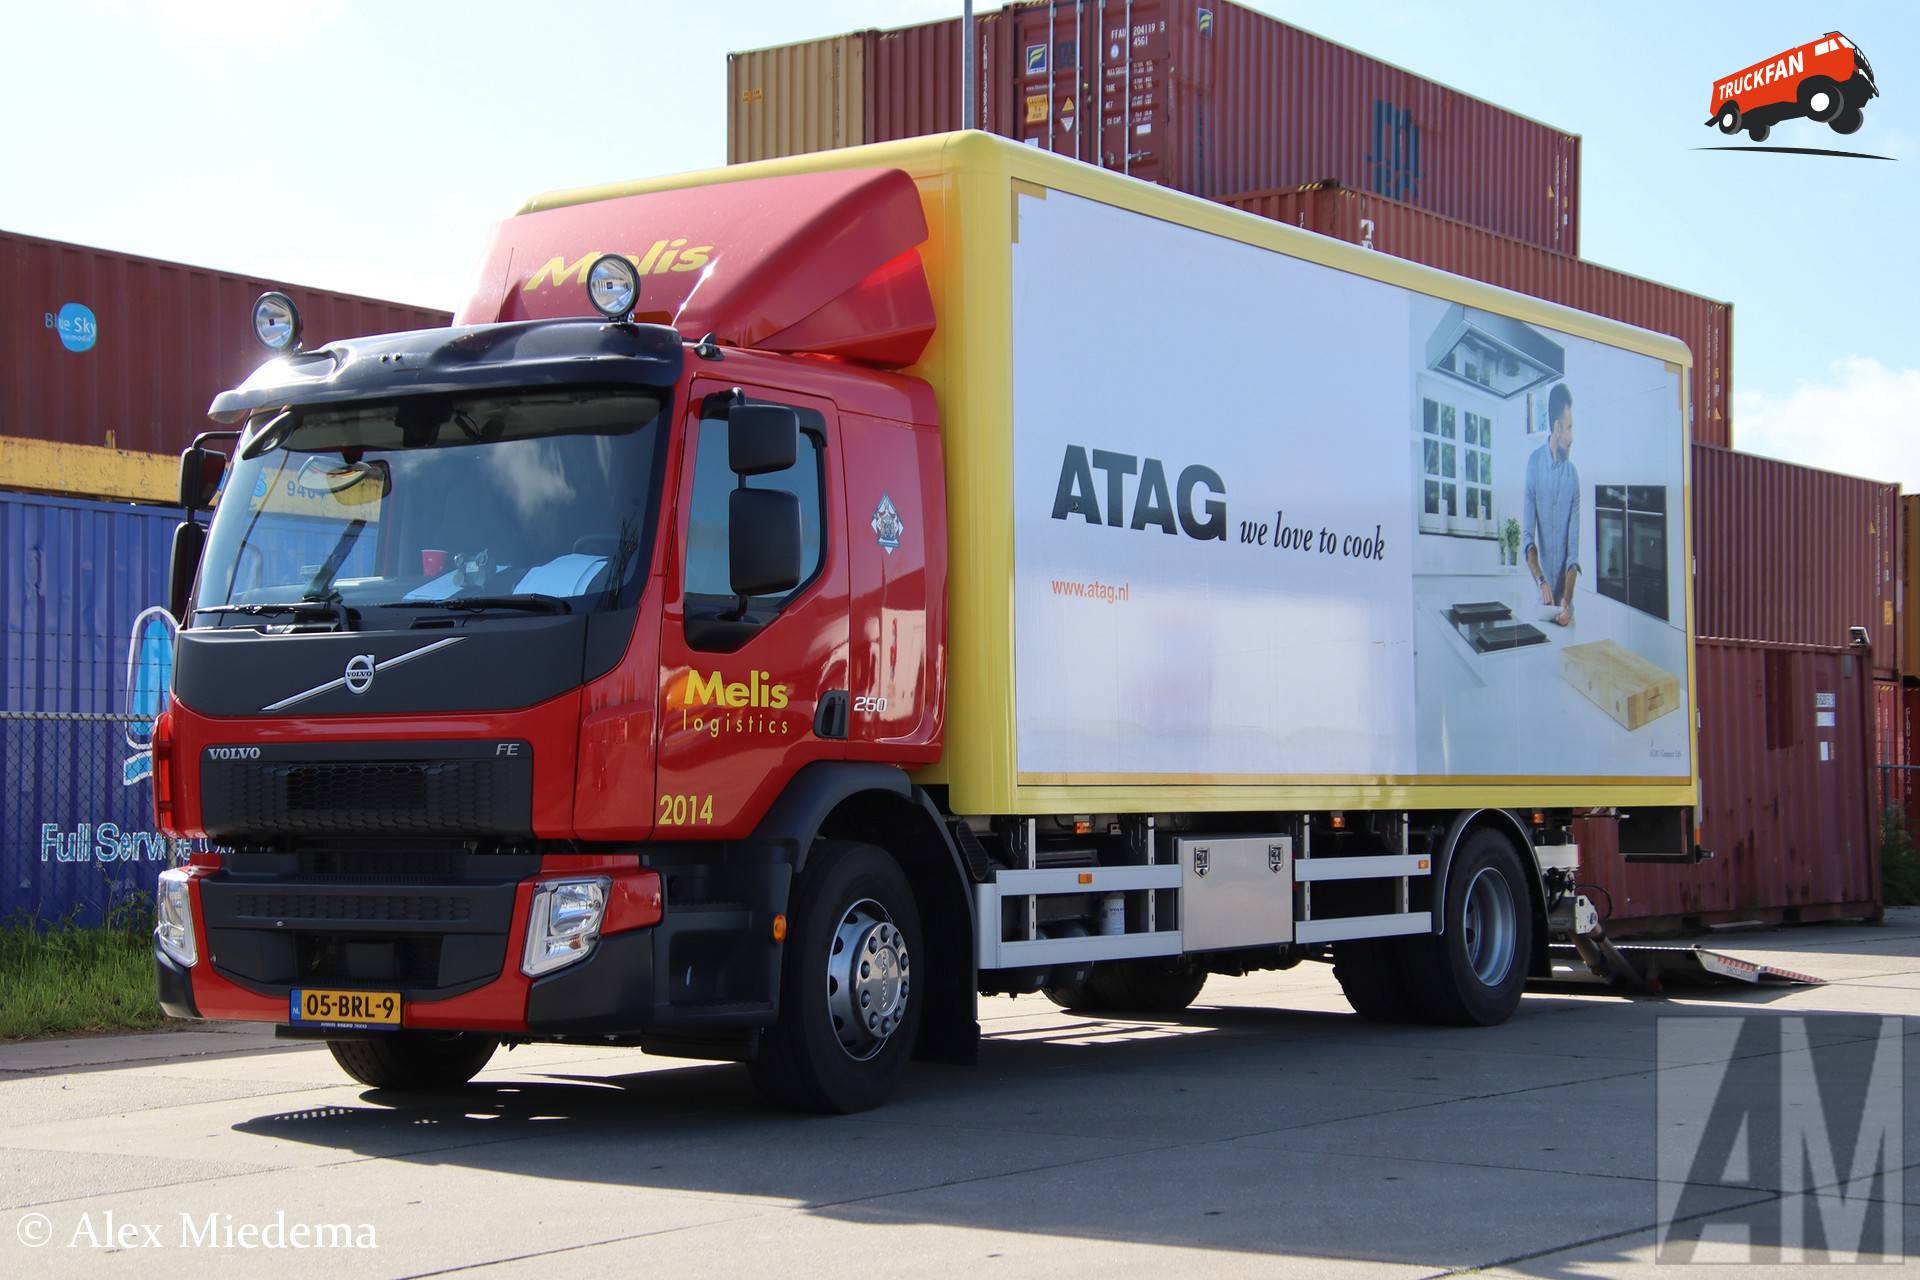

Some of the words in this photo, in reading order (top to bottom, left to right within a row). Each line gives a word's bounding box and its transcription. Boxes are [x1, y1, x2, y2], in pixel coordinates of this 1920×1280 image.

[1133, 23, 1156, 36] 204119
[523, 238, 715, 292] Mlis
[44, 311, 71, 332] Blue
[74, 316, 97, 338] Sky
[1051, 443, 1227, 541] ATAG
[1240, 519, 1268, 546] we
[1273, 510, 1313, 552] love
[1319, 526, 1337, 556] to
[1343, 524, 1385, 560] cook
[1051, 580, 1129, 604] www.atag.nl
[346, 670, 373, 678] VOLVO
[684, 669, 789, 709] Melis
[853, 696, 888, 713] 250
[682, 709, 788, 737] logistics
[208, 746, 261, 760] VOLVO
[495, 743, 520, 756] FE
[658, 794, 713, 826] 2014
[41, 822, 91, 862] Full
[292, 1007, 300, 1015] NL
[306, 994, 394, 1018] 05-BRL-9
